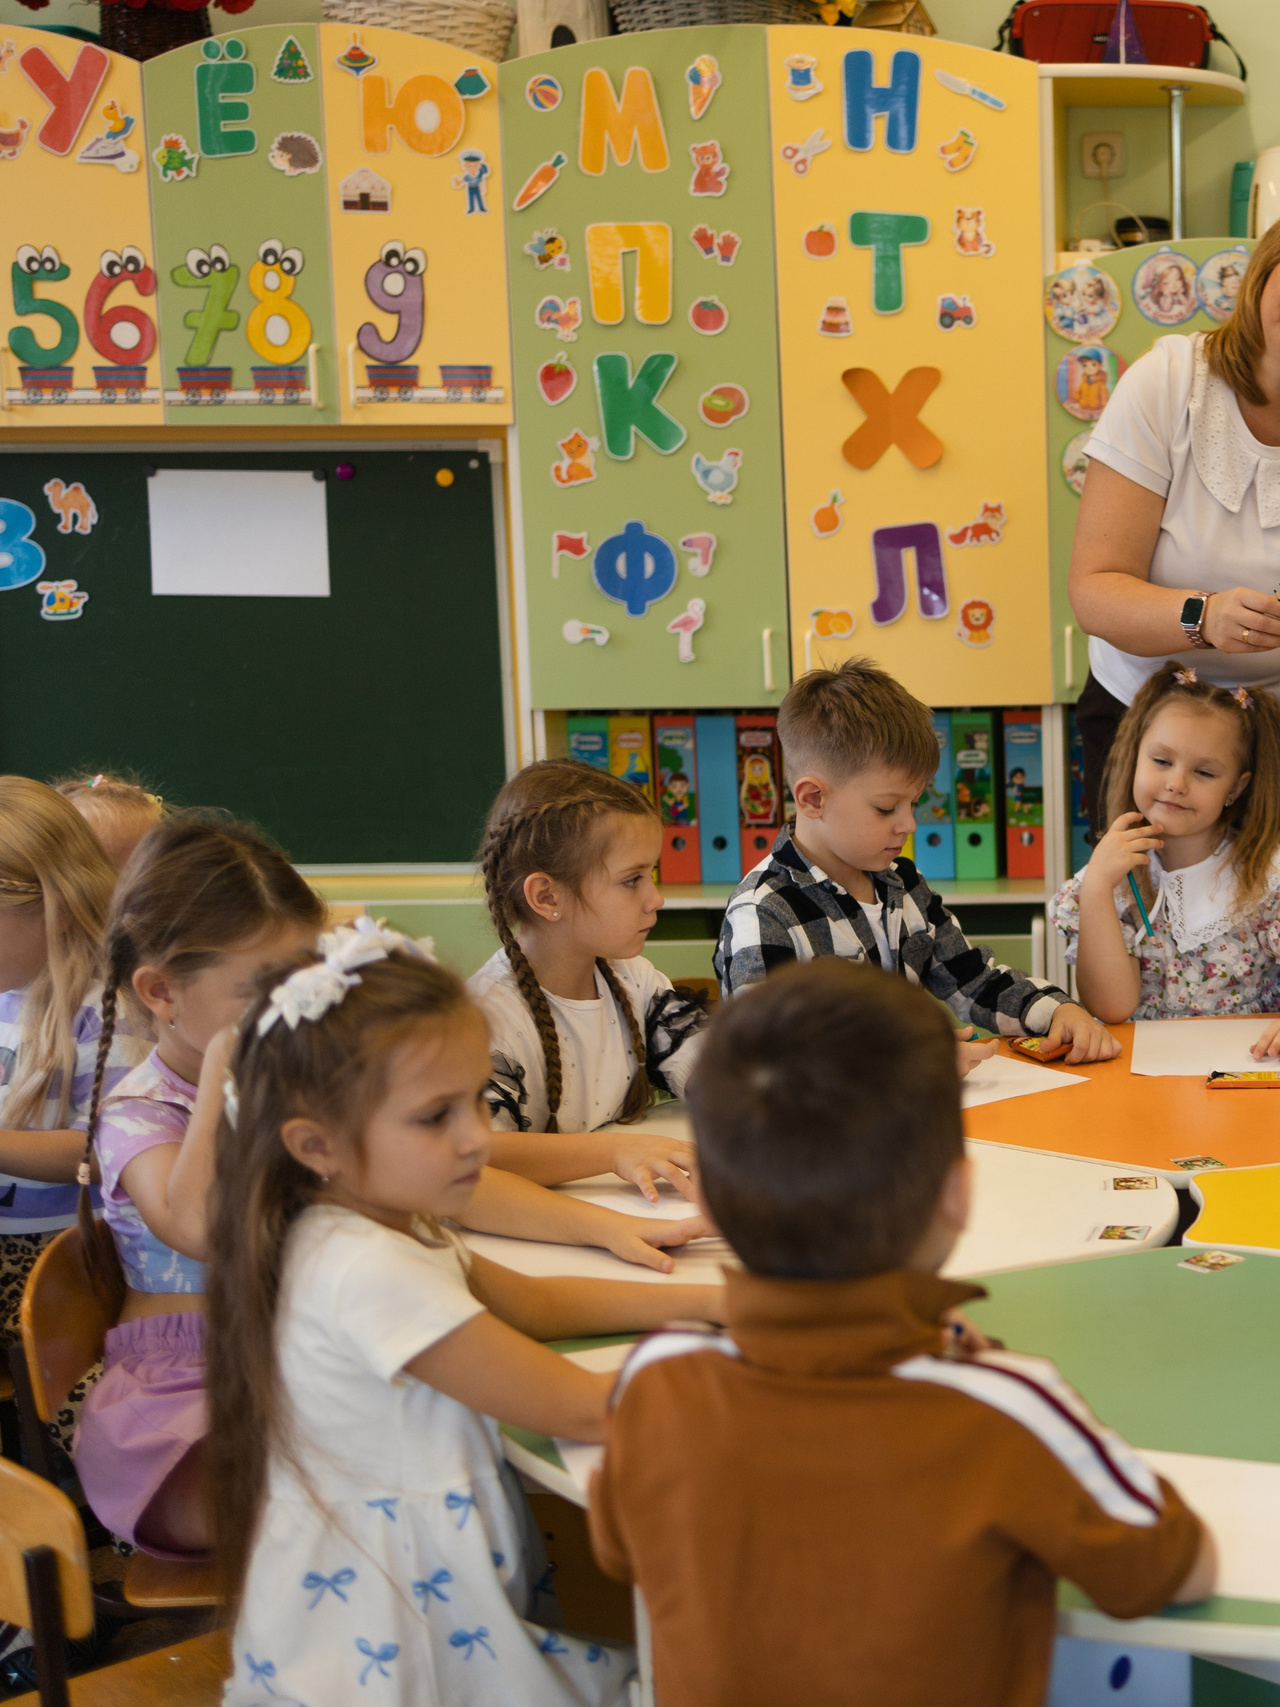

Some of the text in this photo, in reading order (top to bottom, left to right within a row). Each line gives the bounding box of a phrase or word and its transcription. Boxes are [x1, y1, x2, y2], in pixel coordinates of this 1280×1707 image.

[18, 42, 110, 156] У
[195, 38, 258, 158] Ё
[359, 74, 466, 156] Ю
[578, 66, 671, 177] М
[842, 49, 922, 153] Н
[8, 240, 427, 367] 5 6 7 8 9
[586, 221, 673, 325] П
[849, 210, 931, 315] Т
[593, 351, 687, 461] К
[841, 366, 944, 470] Х
[592, 520, 678, 618] Ф
[870, 522, 950, 626] Л
